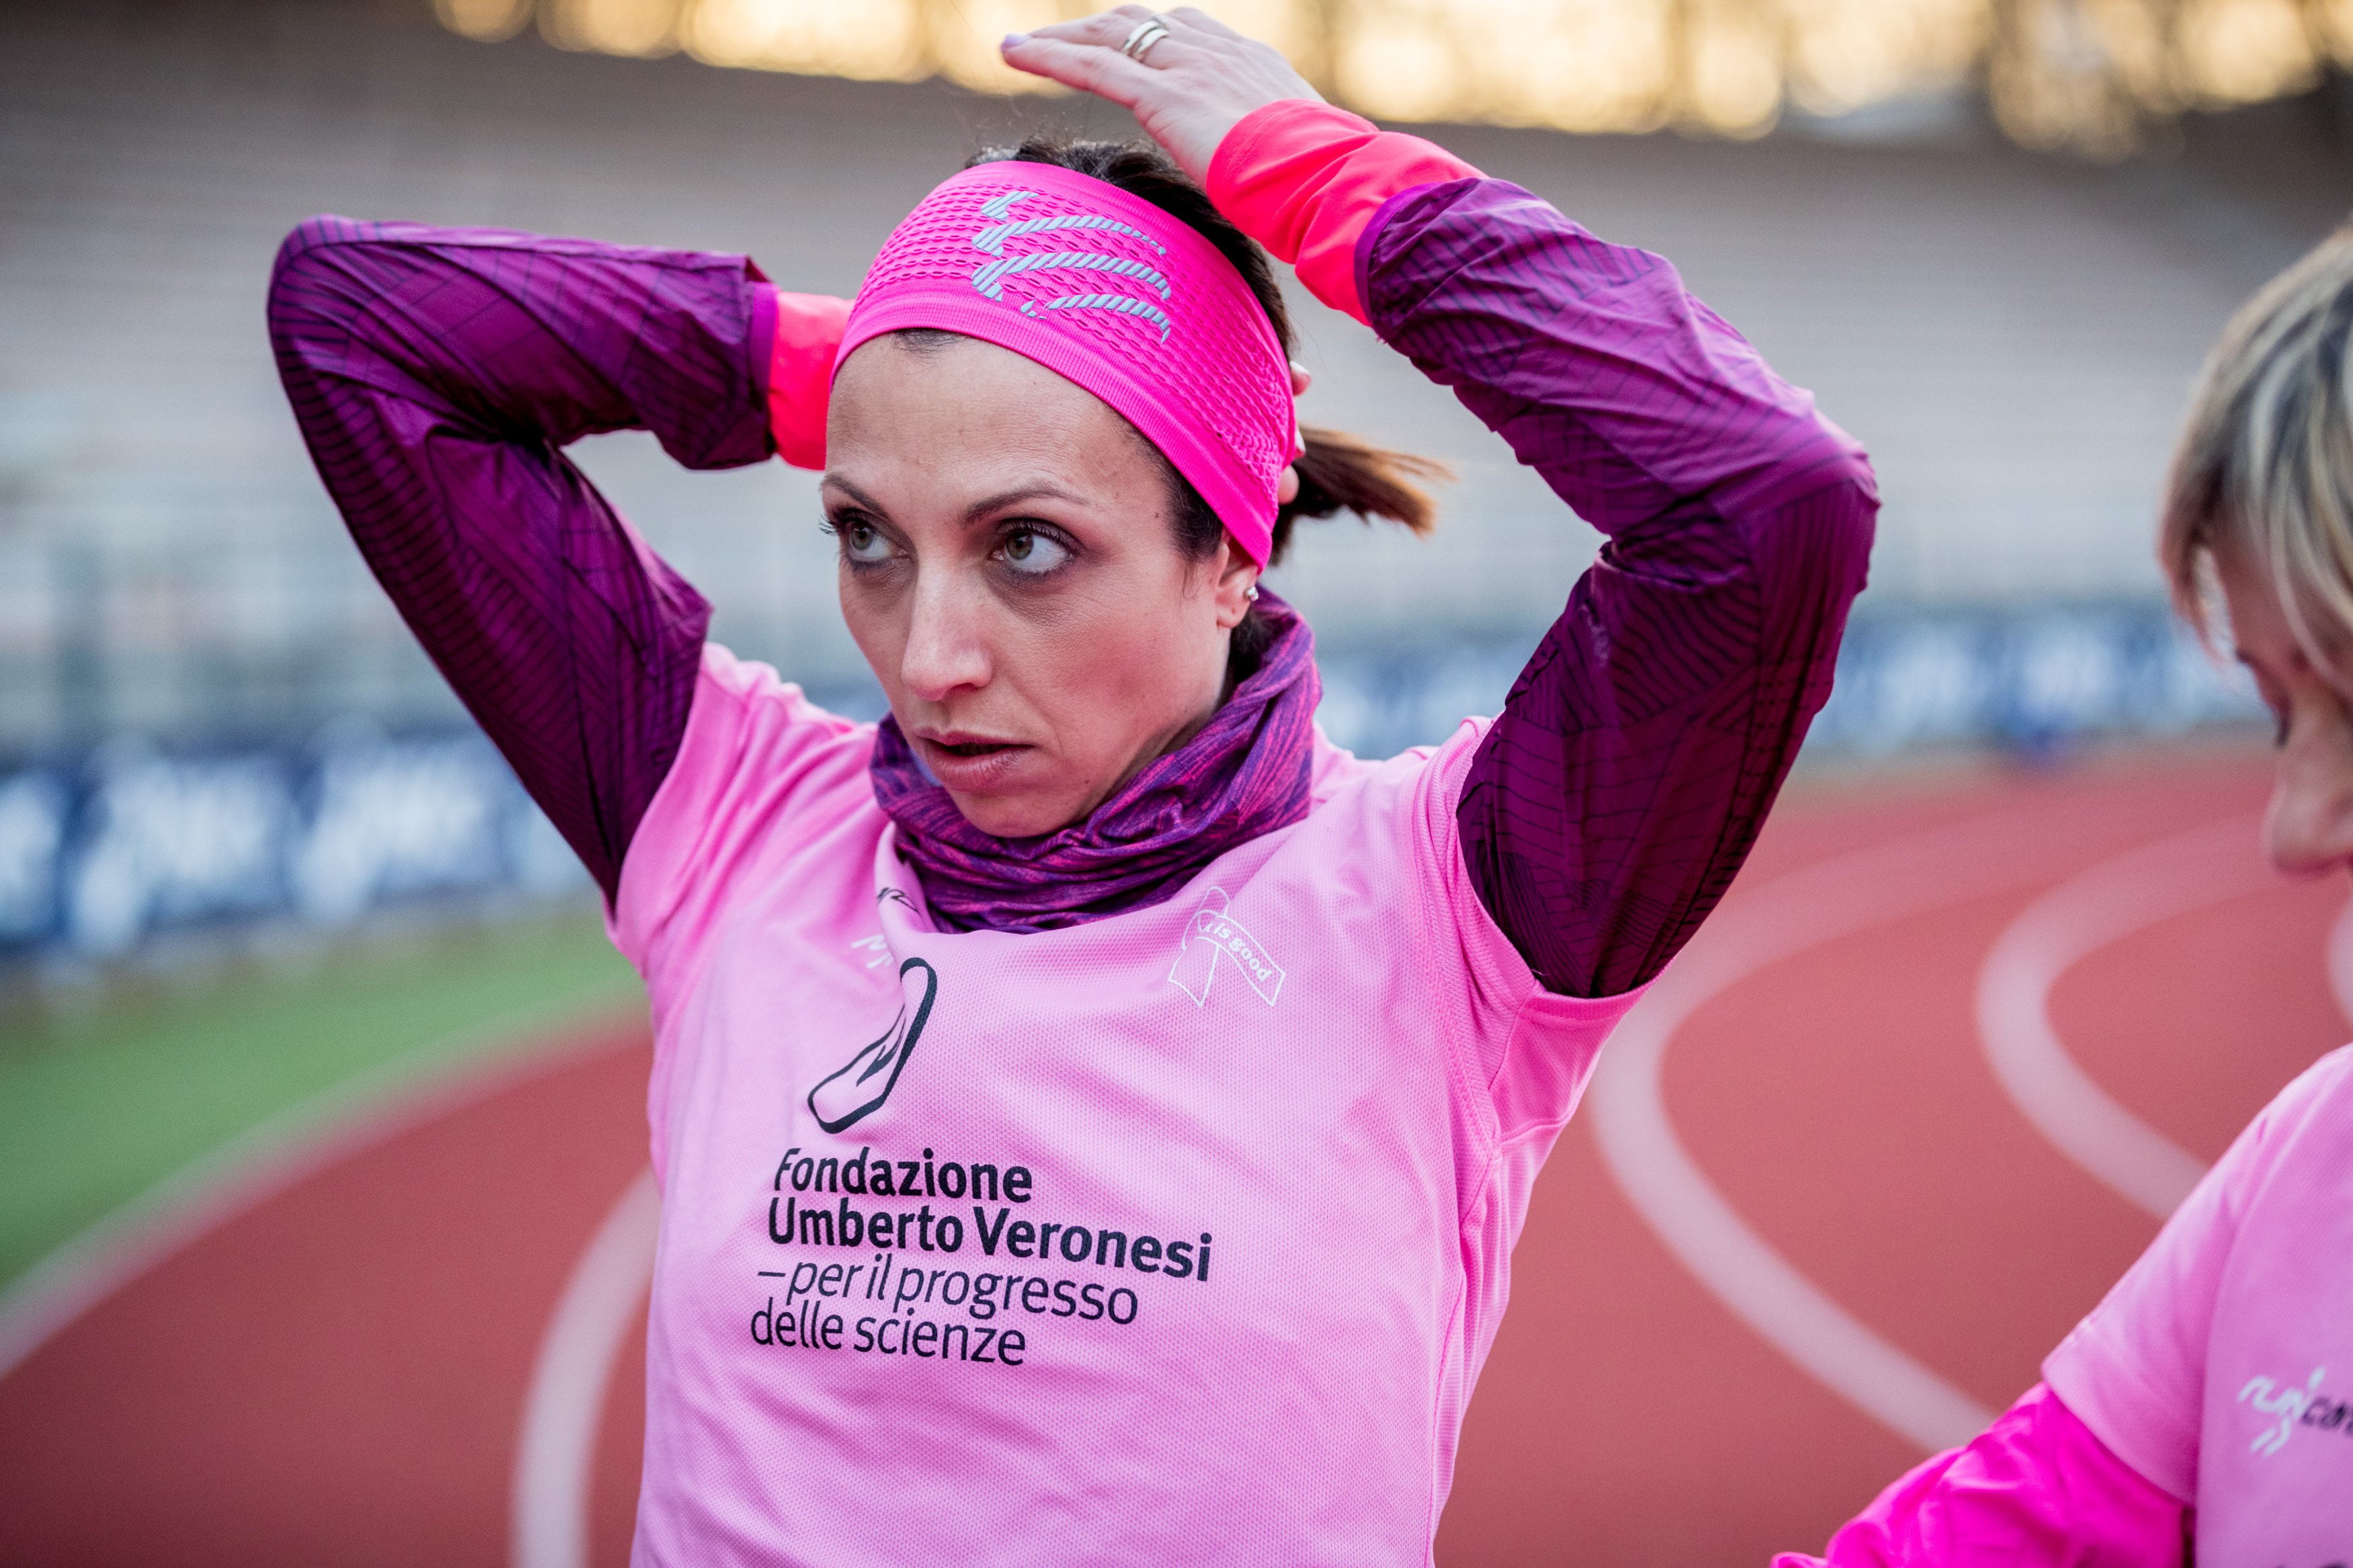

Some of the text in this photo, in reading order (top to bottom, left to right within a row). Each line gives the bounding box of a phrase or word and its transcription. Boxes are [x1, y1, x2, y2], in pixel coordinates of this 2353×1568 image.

[1212, 922, 1273, 983] is good
[774, 1146, 1033, 1204] Fondazione
[768, 1196, 1213, 1282] Umberto Veronesi
[865, 1252, 893, 1301] il
[892, 1266, 1139, 1325] progresso
[750, 1296, 1027, 1366] delle scienze
